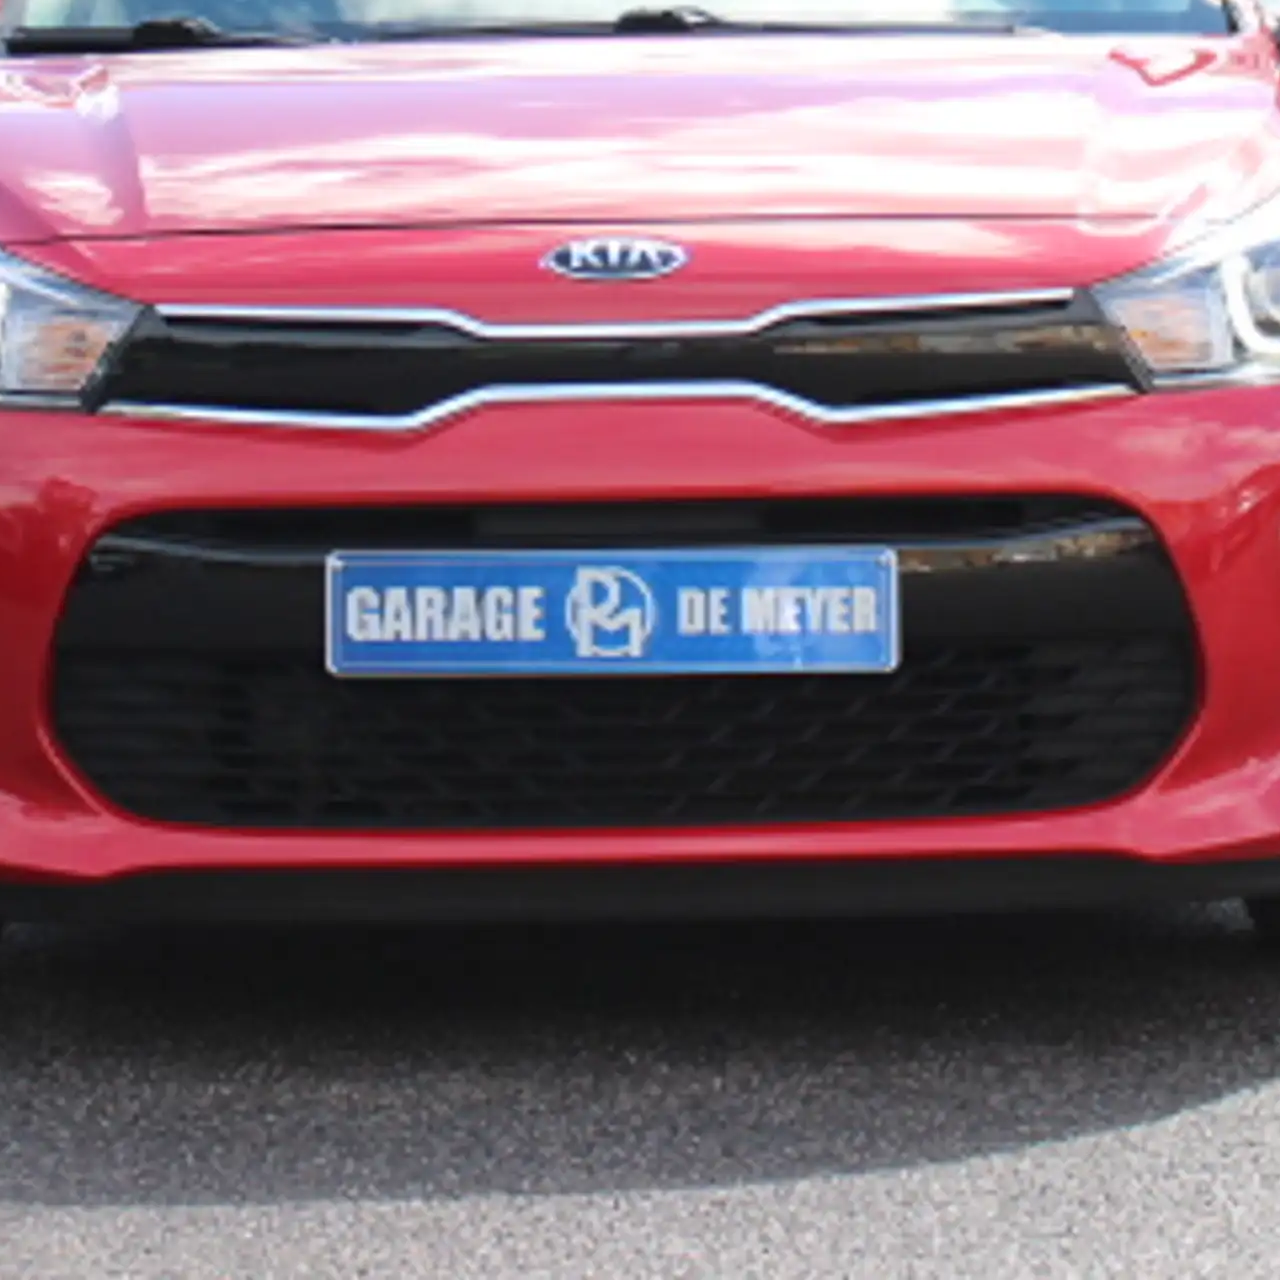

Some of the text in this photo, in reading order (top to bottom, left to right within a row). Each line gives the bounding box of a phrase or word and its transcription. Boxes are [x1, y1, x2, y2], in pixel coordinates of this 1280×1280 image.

[568, 238, 670, 270] KIA
[345, 586, 546, 642] GARAGE
[677, 588, 728, 635] DE
[742, 586, 879, 636] MEYER
